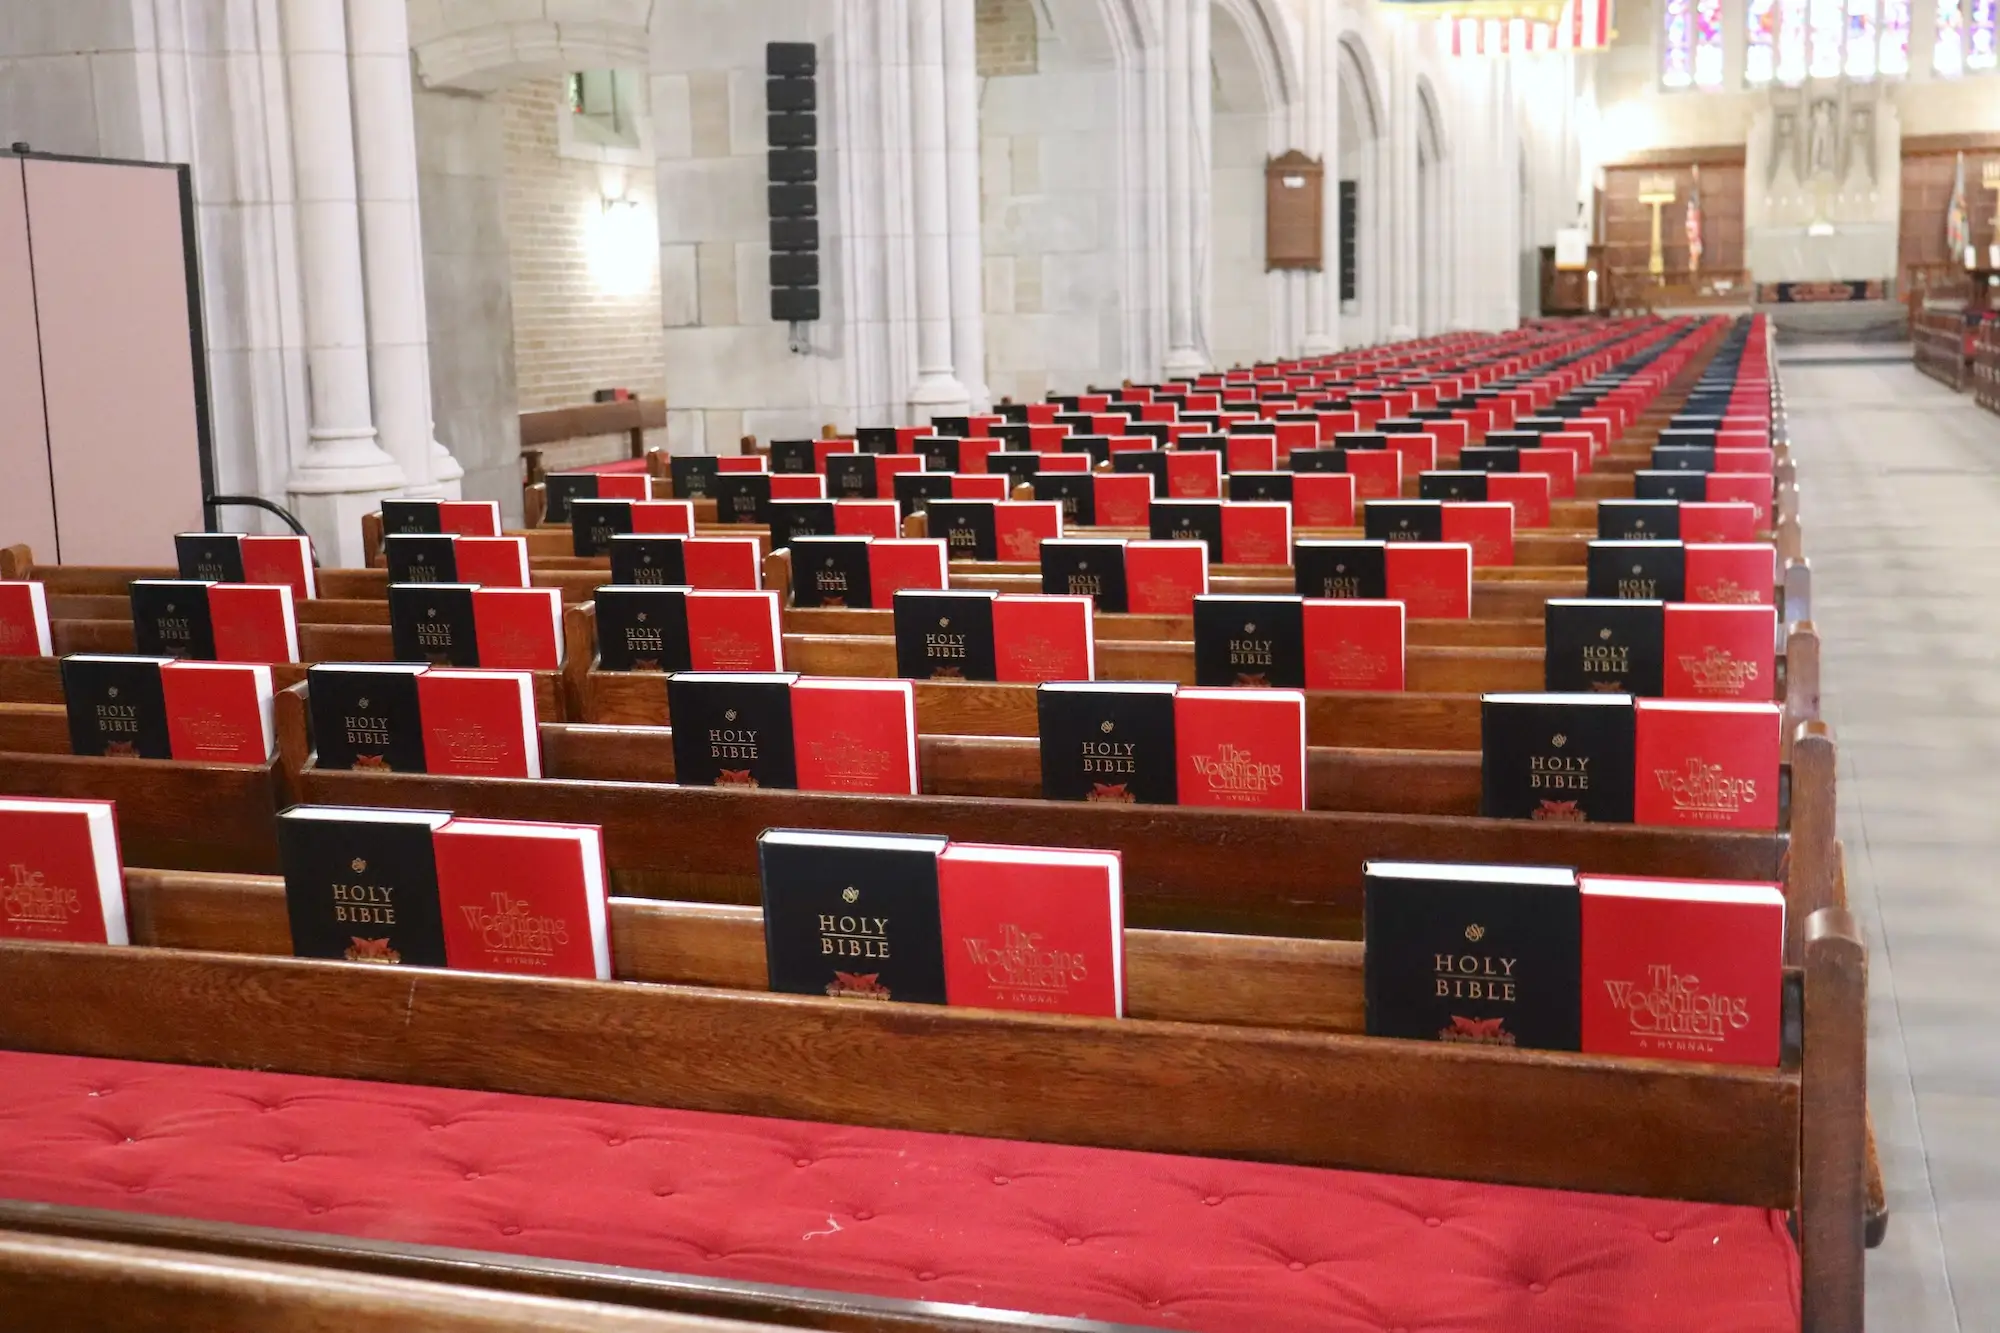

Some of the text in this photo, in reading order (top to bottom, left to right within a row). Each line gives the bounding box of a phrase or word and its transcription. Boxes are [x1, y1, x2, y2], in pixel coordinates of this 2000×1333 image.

[1068, 575, 1100, 584] HOLY
[1323, 577, 1360, 588] HOLY
[416, 623, 451, 634] HOLY
[625, 628, 662, 638] HOLY
[418, 635, 452, 646] BIBLE
[627, 640, 663, 651] BIBLE
[926, 633, 965, 645] HOLY
[1229, 639, 1272, 651] HOLY
[927, 646, 966, 658] BIBLE
[1230, 653, 1272, 665] BIBLE
[1583, 646, 1629, 658] HOLY
[1583, 660, 1629, 673] BIBLE
[96, 704, 136, 717] HOLY
[99, 719, 139, 732] BIBLE
[344, 716, 388, 730] HOLY
[347, 731, 390, 745] BIBLE
[708, 729, 757, 743] HOLY
[711, 745, 758, 759] BIBLE
[1082, 741, 1136, 756] HOLY
[1218, 743, 1251, 764] The
[1083, 758, 1136, 773] BIBLE
[1191, 754, 1283, 786] Worshiping
[1530, 756, 1590, 771] HOLY
[1685, 757, 1723, 779] The
[1531, 774, 1589, 790] BIBLE
[9, 864, 45, 886] The
[332, 883, 394, 903] HOLY
[490, 891, 530, 916] The
[335, 905, 396, 925] BIBLE
[459, 905, 570, 945] Worshiping
[818, 914, 889, 935] HOLY
[482, 921, 554, 952] Church
[999, 922, 1043, 952] The
[821, 937, 890, 958] BIBLE
[962, 937, 1088, 982] Worshiping
[1433, 953, 1517, 976] HOLY
[987, 956, 1068, 988] Church
[1648, 963, 1701, 995] The
[1435, 978, 1517, 1001] BIBLE
[1603, 979, 1750, 1029] Worshiping
[1628, 1002, 1725, 1035] Church
[1657, 1040, 1714, 1053] HYMNAL
